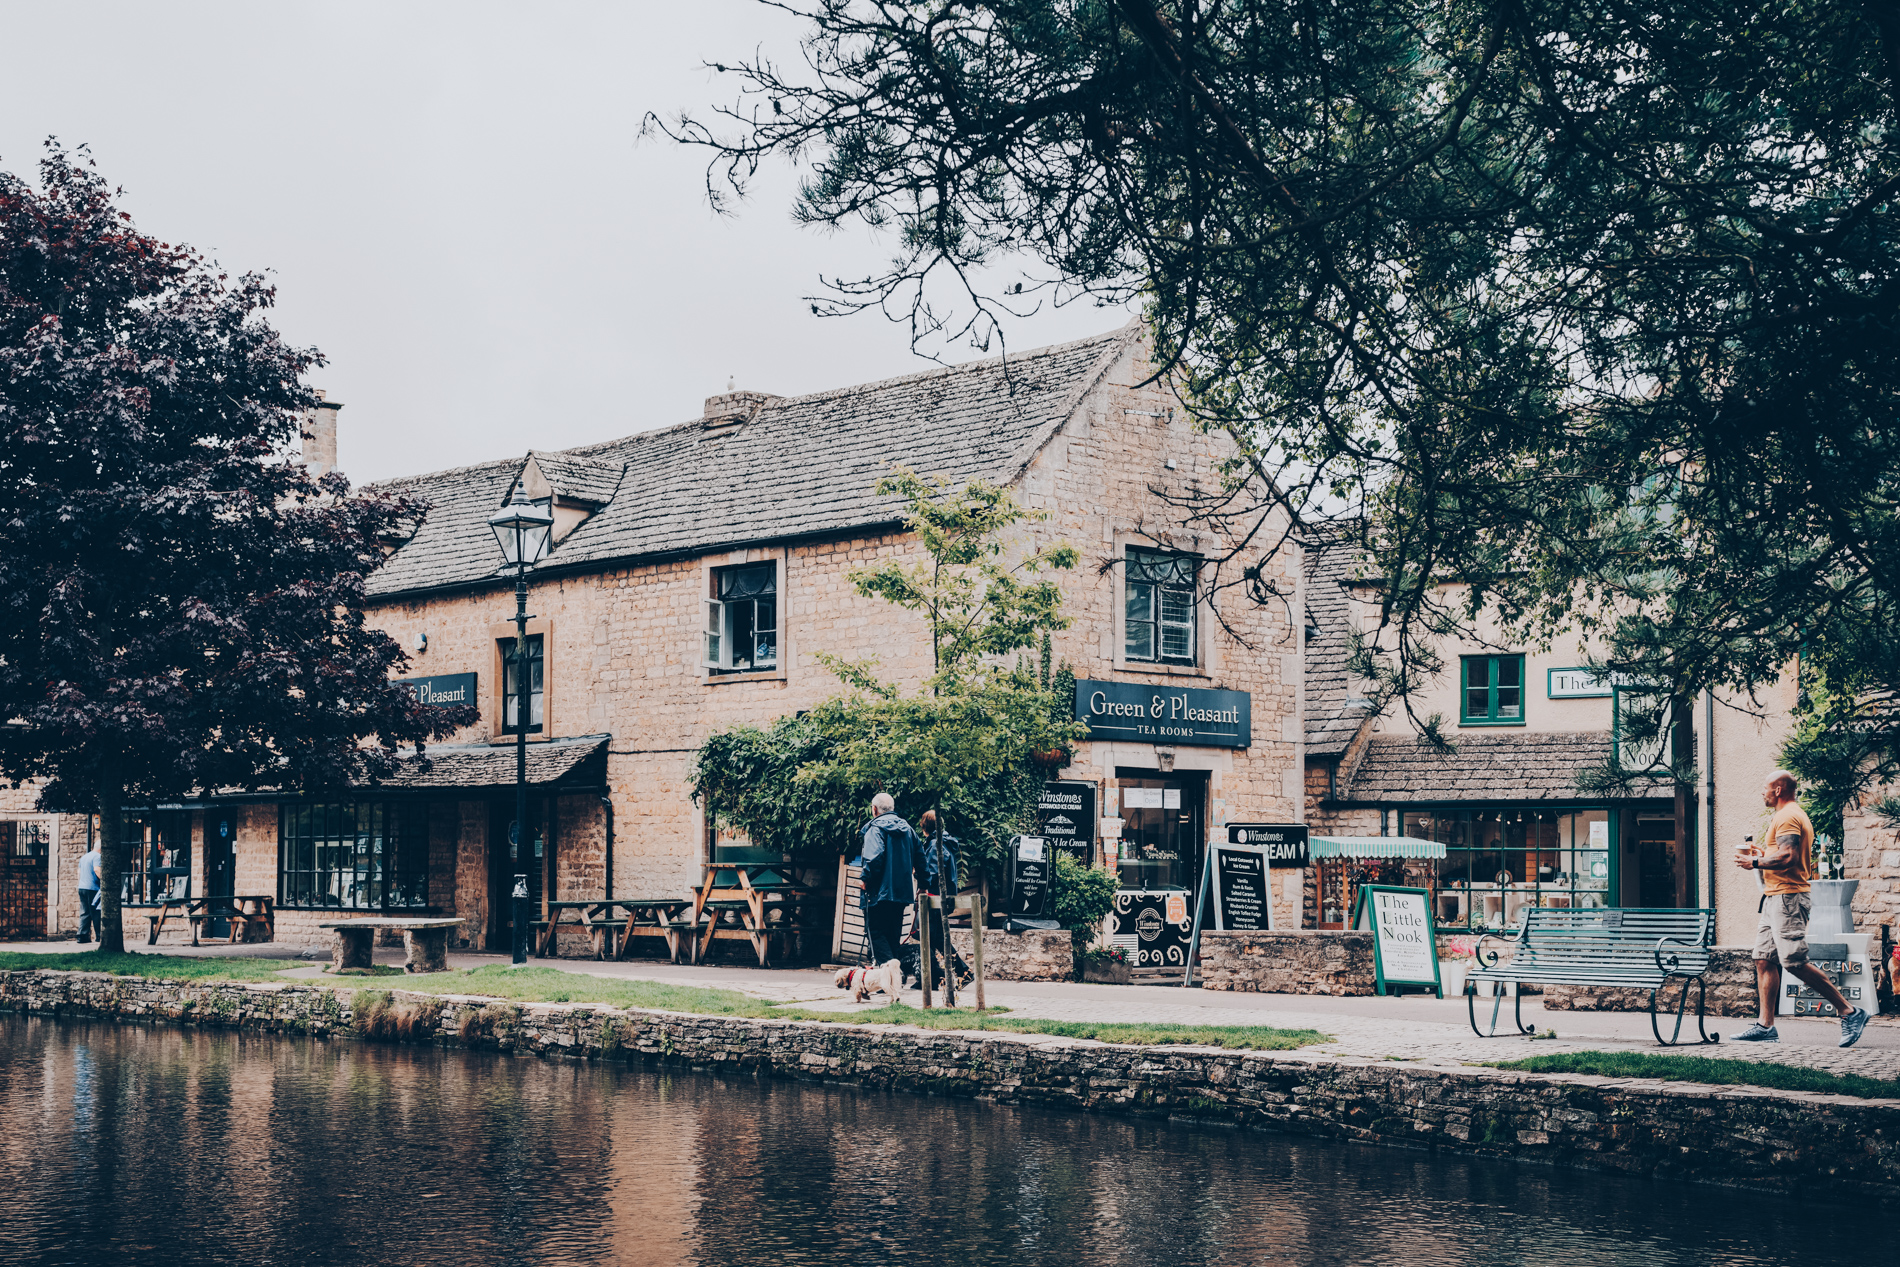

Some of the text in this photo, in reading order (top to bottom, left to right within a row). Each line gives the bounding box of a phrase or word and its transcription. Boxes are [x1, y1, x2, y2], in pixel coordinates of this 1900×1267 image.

[420, 681, 466, 704] Pleasant
[1090, 691, 1239, 724] Green & Pleasant
[1137, 725, 1194, 737] TEA ROOMS
[1039, 790, 1082, 804] Winstones
[1044, 826, 1076, 834] Traditional
[1248, 830, 1284, 841] Winstones
[1069, 838, 1087, 847] Cream
[1380, 895, 1409, 909] The
[1383, 911, 1422, 926] Little
[1383, 927, 1422, 943] Nook
